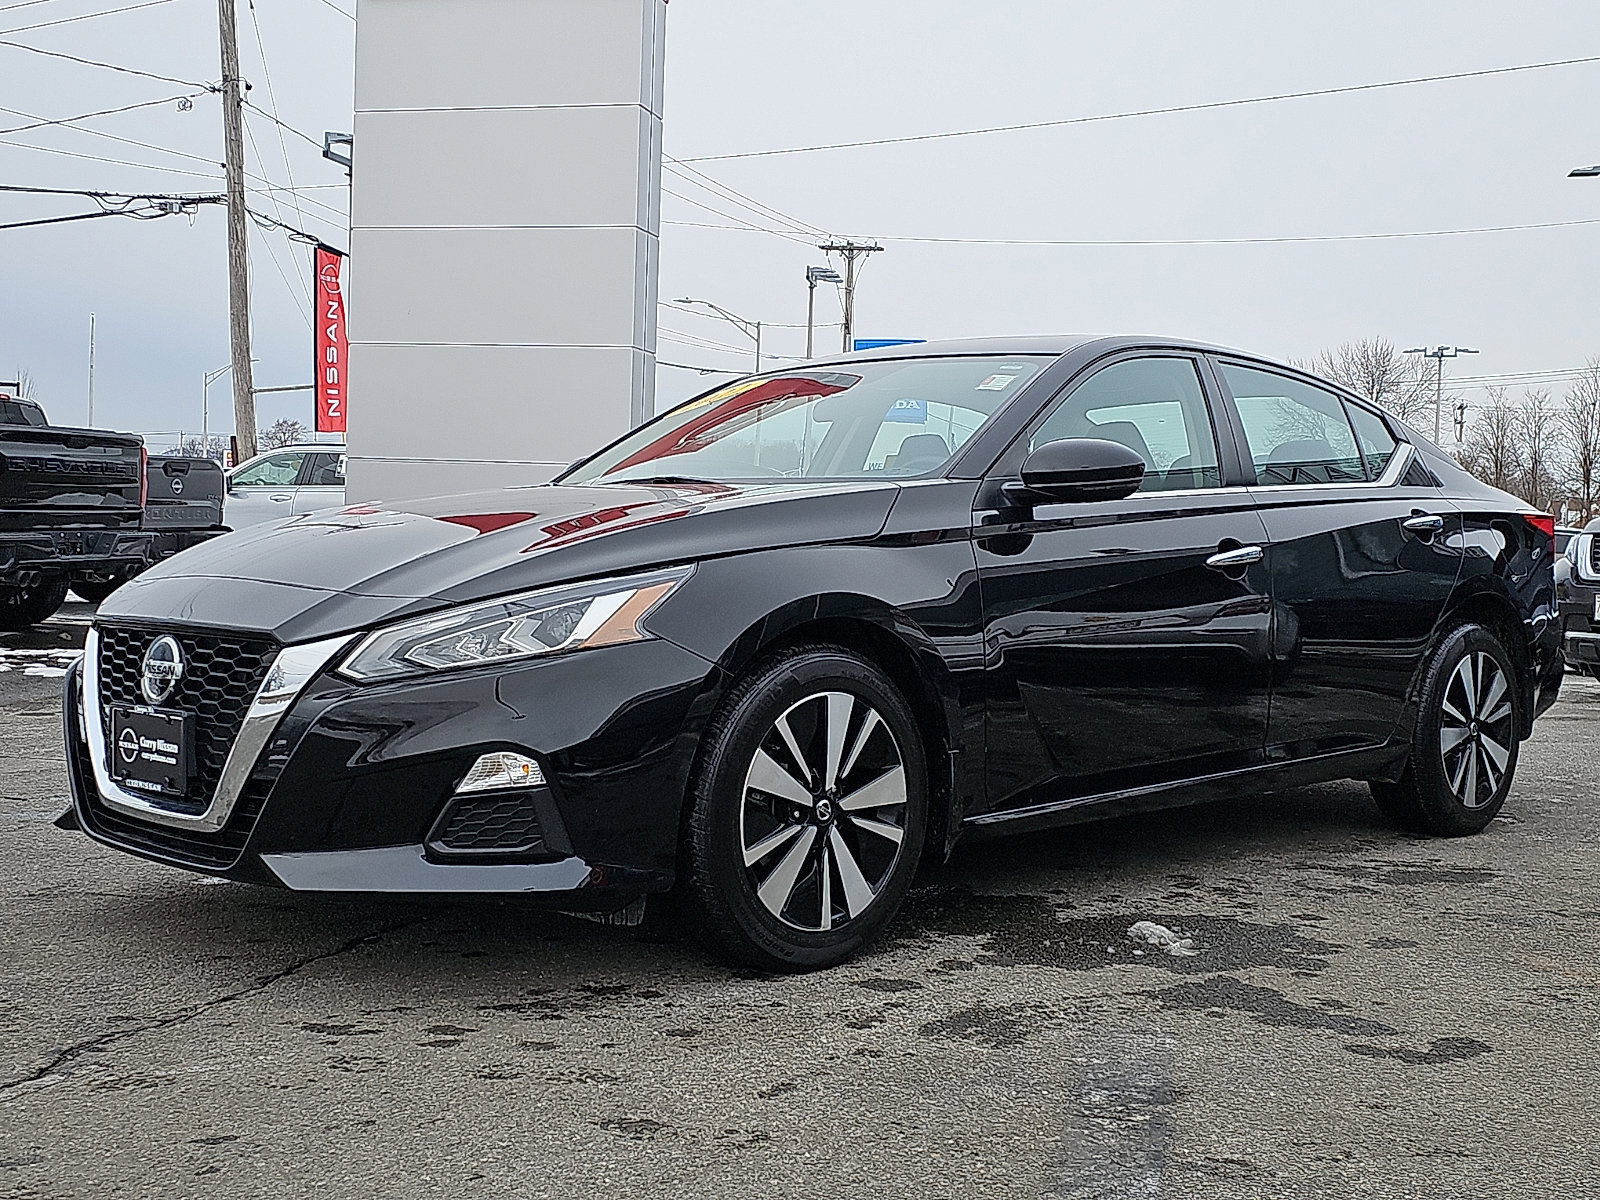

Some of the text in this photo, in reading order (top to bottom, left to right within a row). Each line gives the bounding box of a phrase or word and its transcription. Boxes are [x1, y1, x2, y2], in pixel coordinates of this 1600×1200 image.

[326, 301, 341, 417] NISSAN
[890, 400, 921, 409] DA
[6, 459, 137, 477] CHEVROLET
[146, 663, 178, 676] NISSAN
[140, 736, 157, 751] Curry
